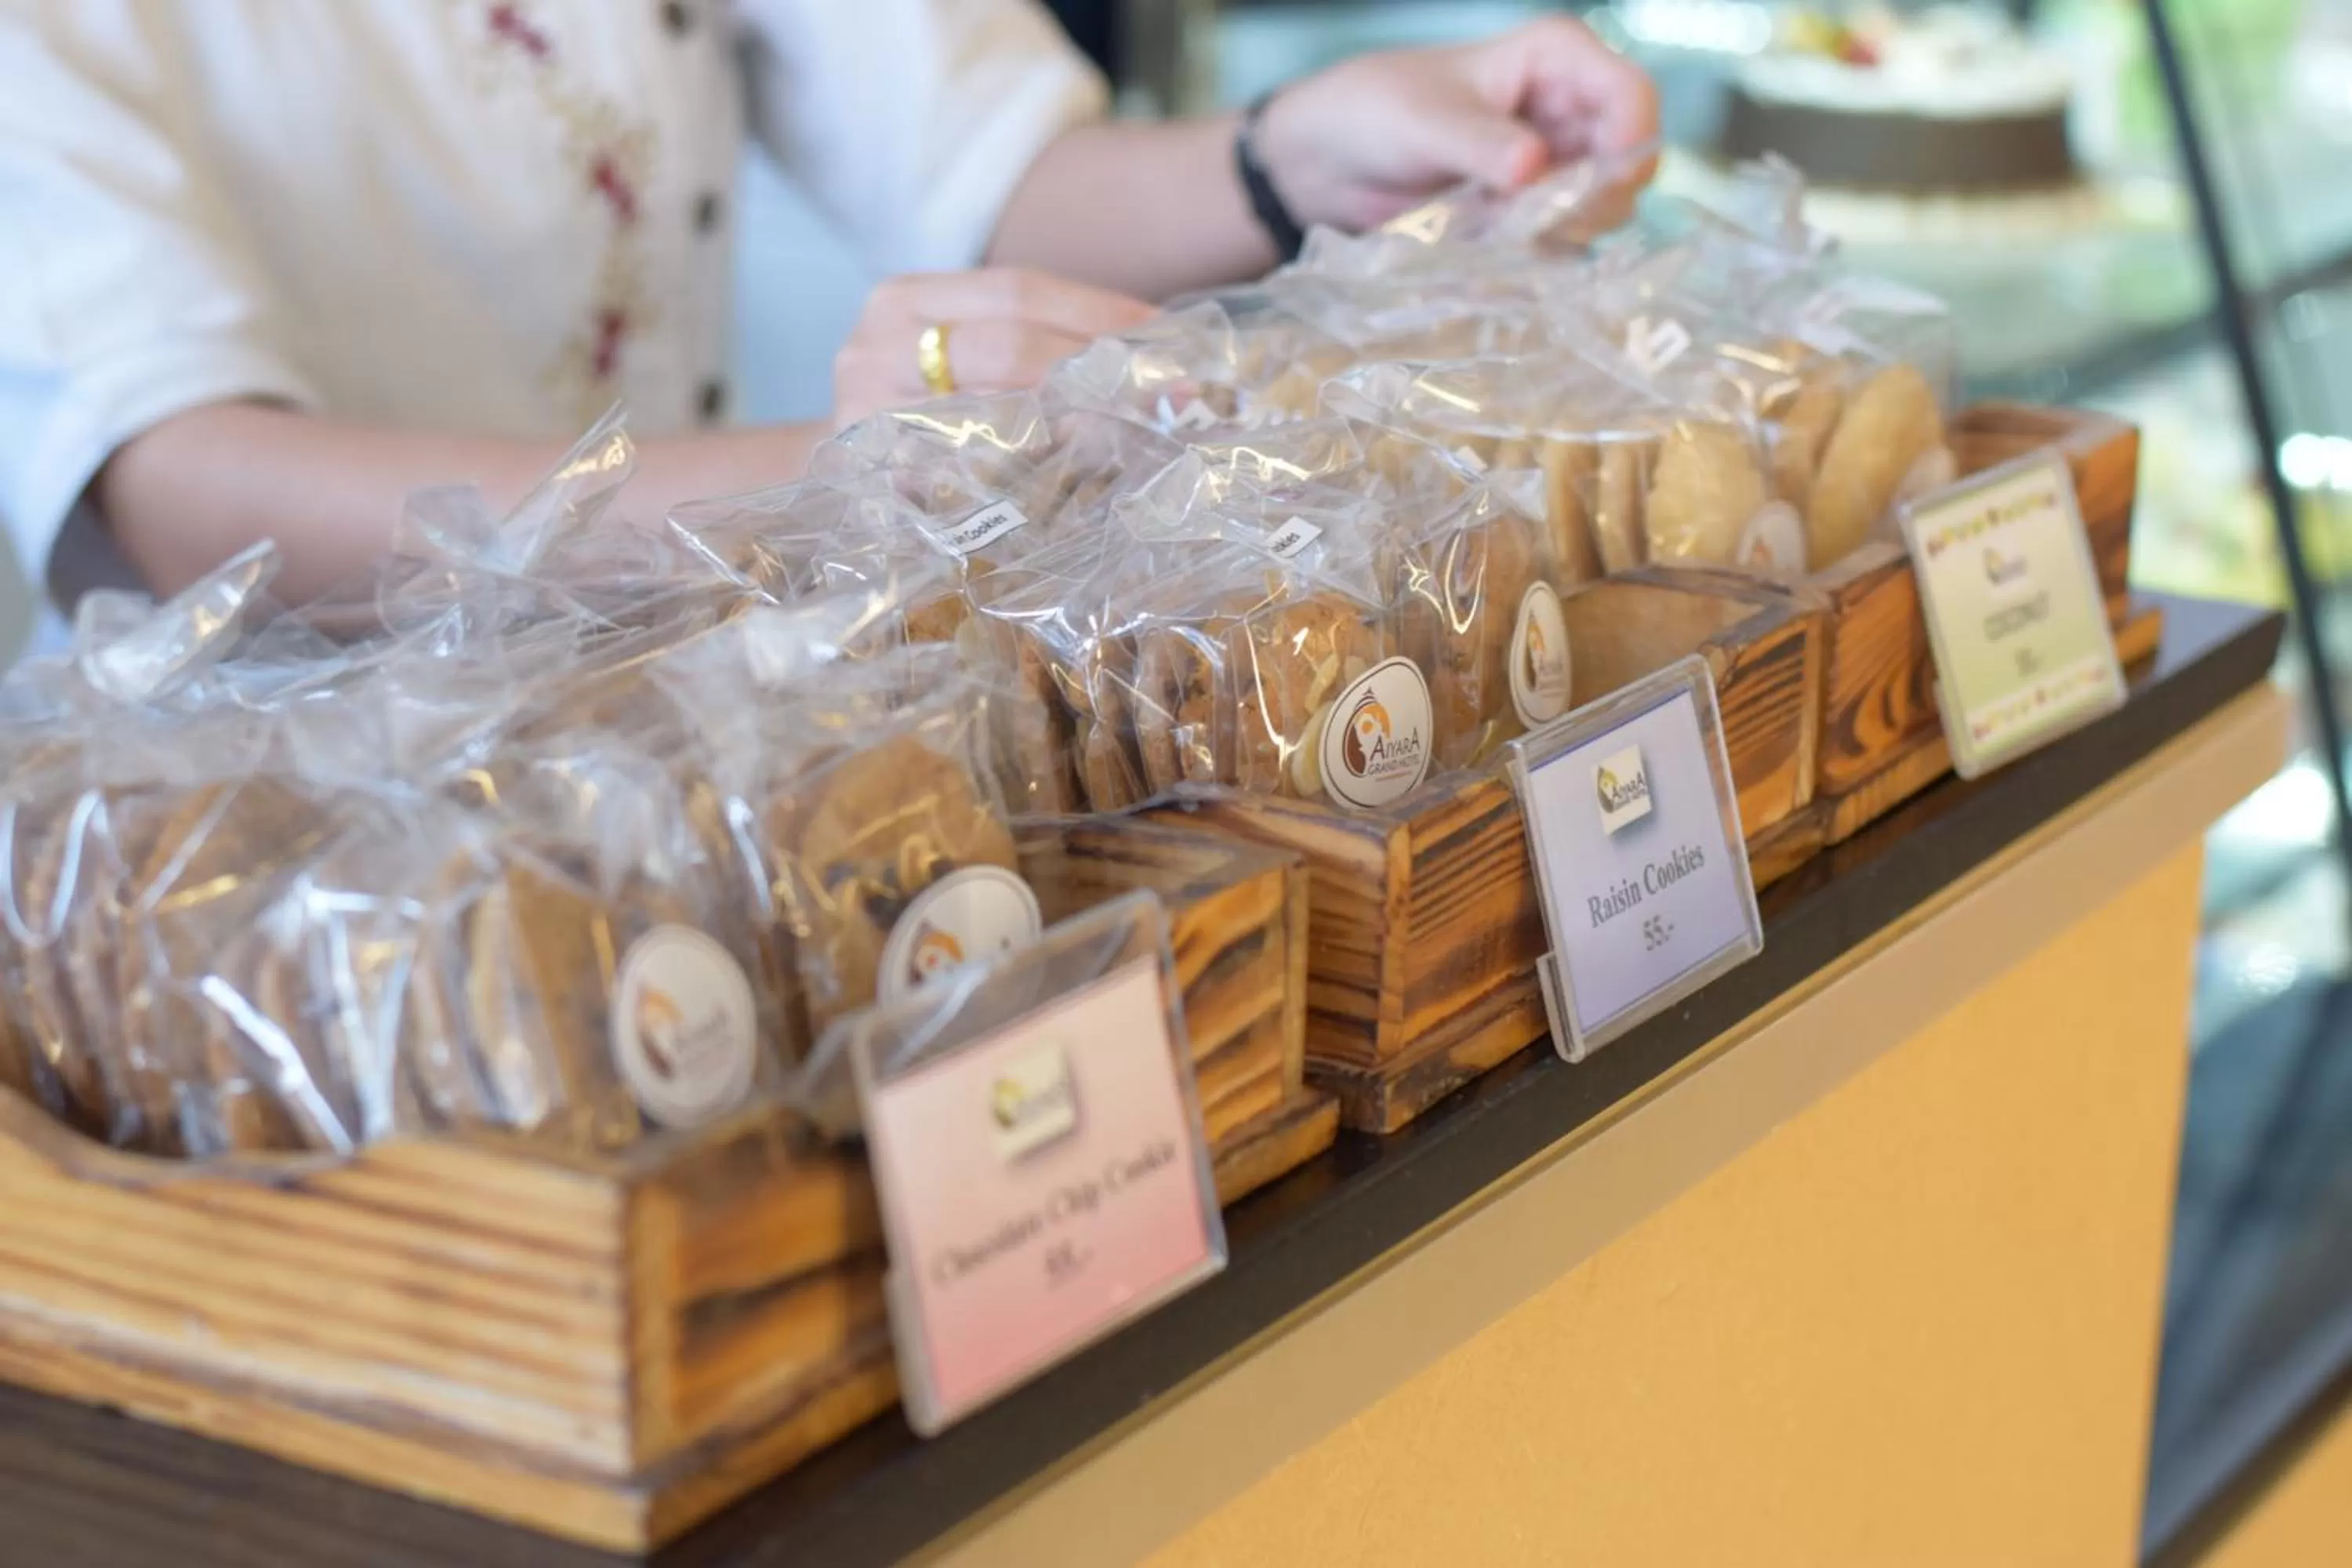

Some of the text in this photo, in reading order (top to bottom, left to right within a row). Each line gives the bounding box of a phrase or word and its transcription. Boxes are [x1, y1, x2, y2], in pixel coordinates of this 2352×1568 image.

[1370, 727, 1421, 761] AIYARA
[1587, 844, 1705, 928] Raisin Cookies
